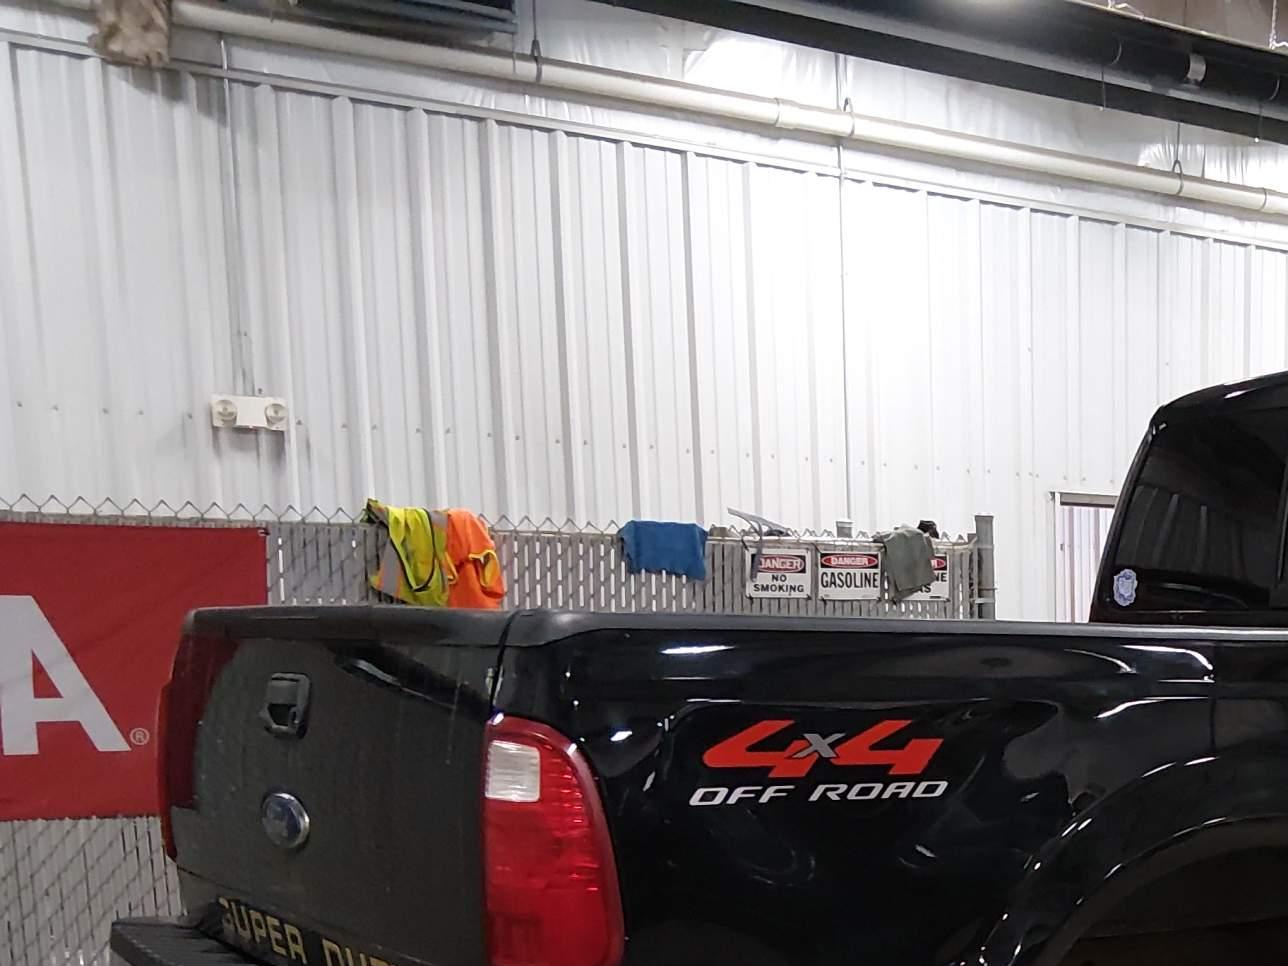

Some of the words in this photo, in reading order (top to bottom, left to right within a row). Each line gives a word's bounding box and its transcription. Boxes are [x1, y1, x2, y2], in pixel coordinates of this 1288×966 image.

[831, 556, 869, 566] DANGER
[771, 574, 787, 582] NO
[820, 571, 879, 589] GASOLINE
[753, 583, 805, 593] SMOKING
[689, 785, 795, 806] OFF
[808, 780, 949, 802] ROAD
